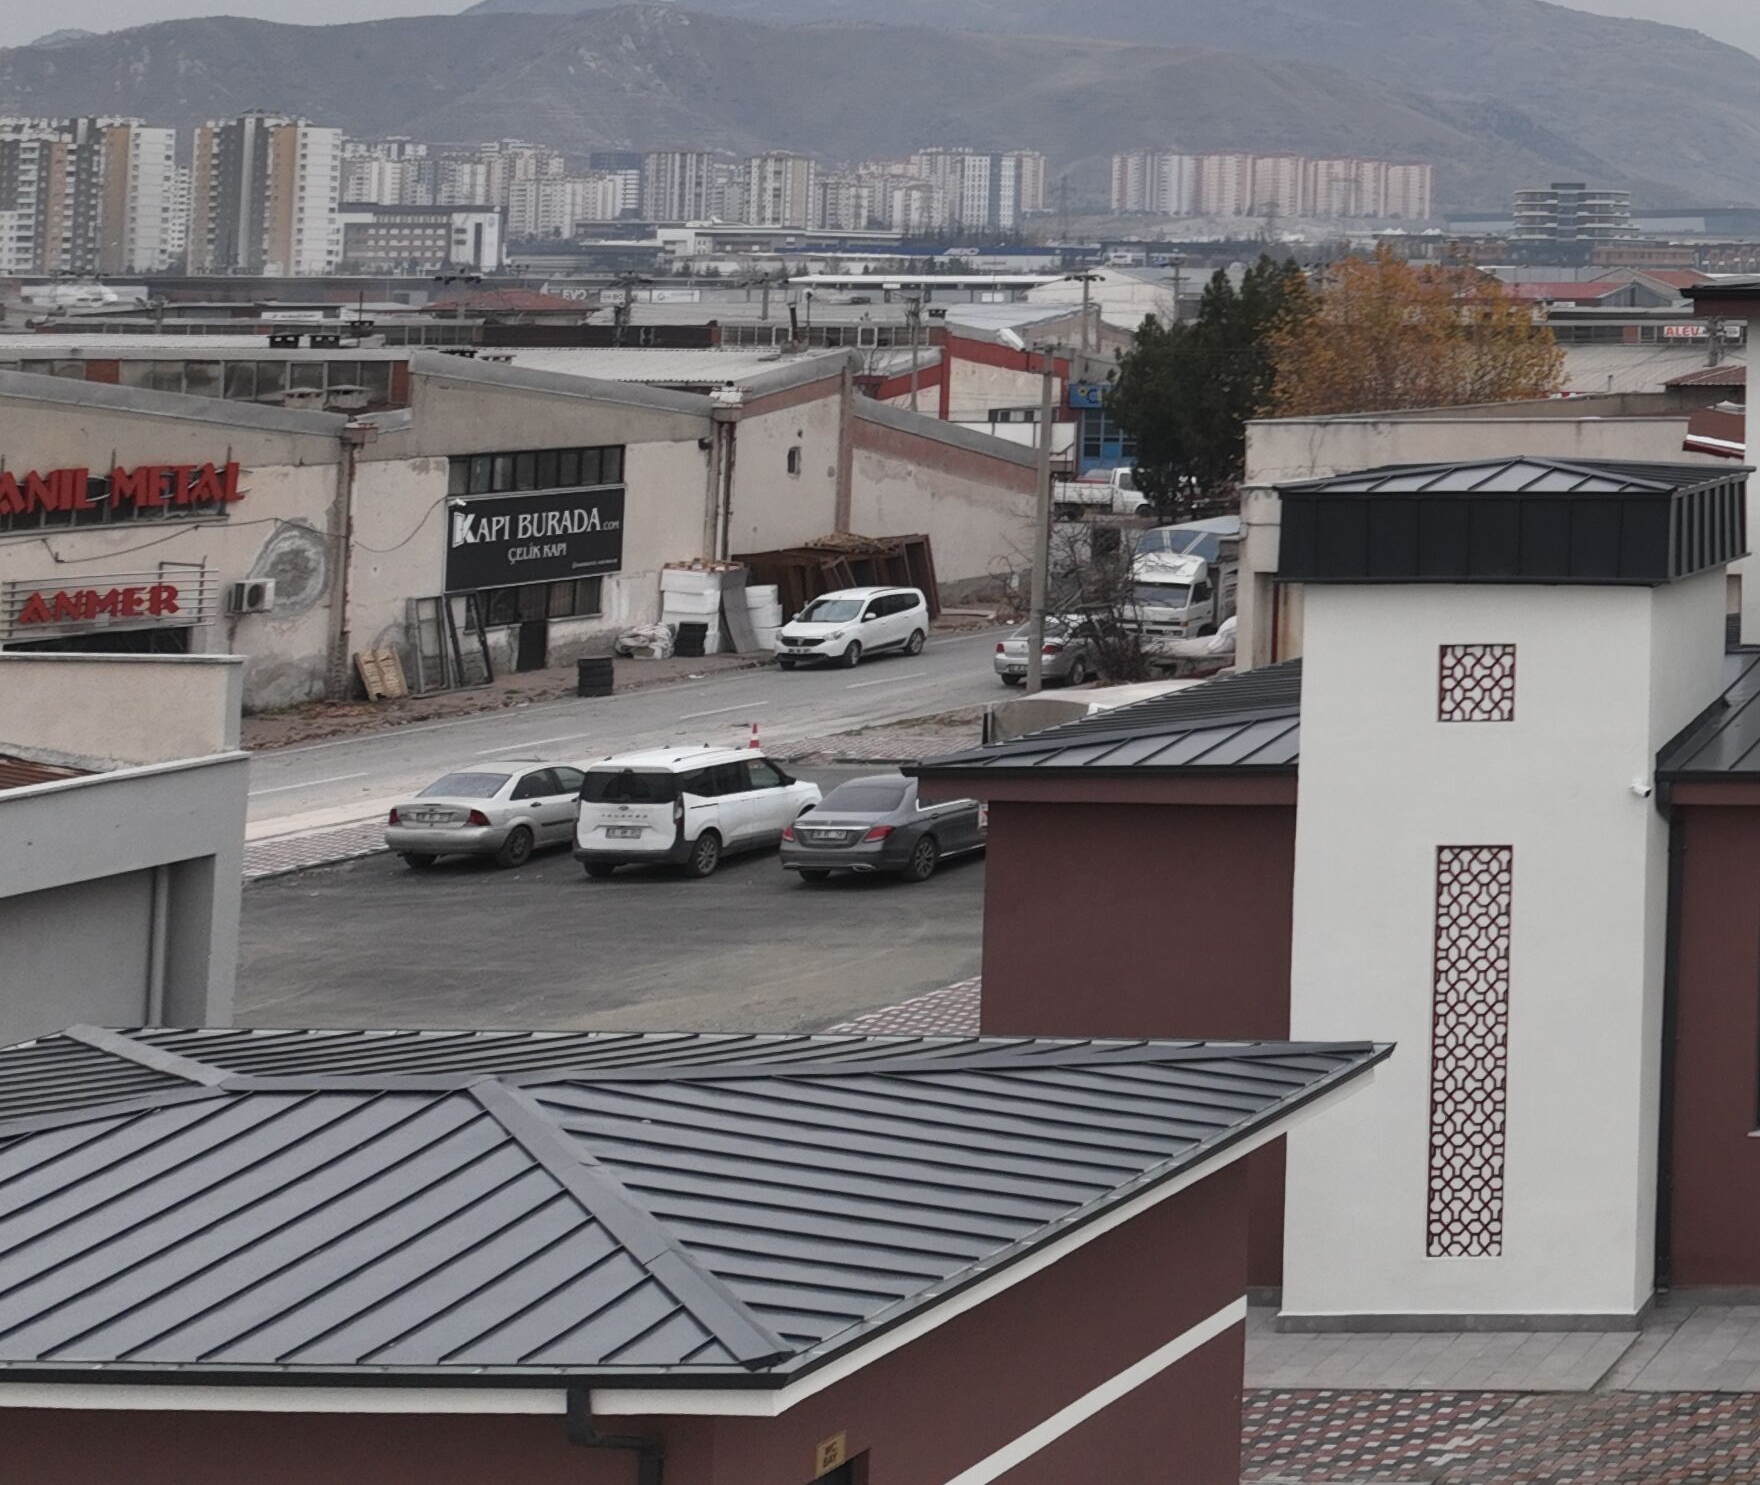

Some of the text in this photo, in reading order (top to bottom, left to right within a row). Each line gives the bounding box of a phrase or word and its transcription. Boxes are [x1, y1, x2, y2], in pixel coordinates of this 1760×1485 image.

[110, 462, 245, 508] METAL
[452, 511, 511, 548] KAPI
[508, 541, 567, 565] ÇELİK KAPI
[18, 585, 181, 624] ANMER
